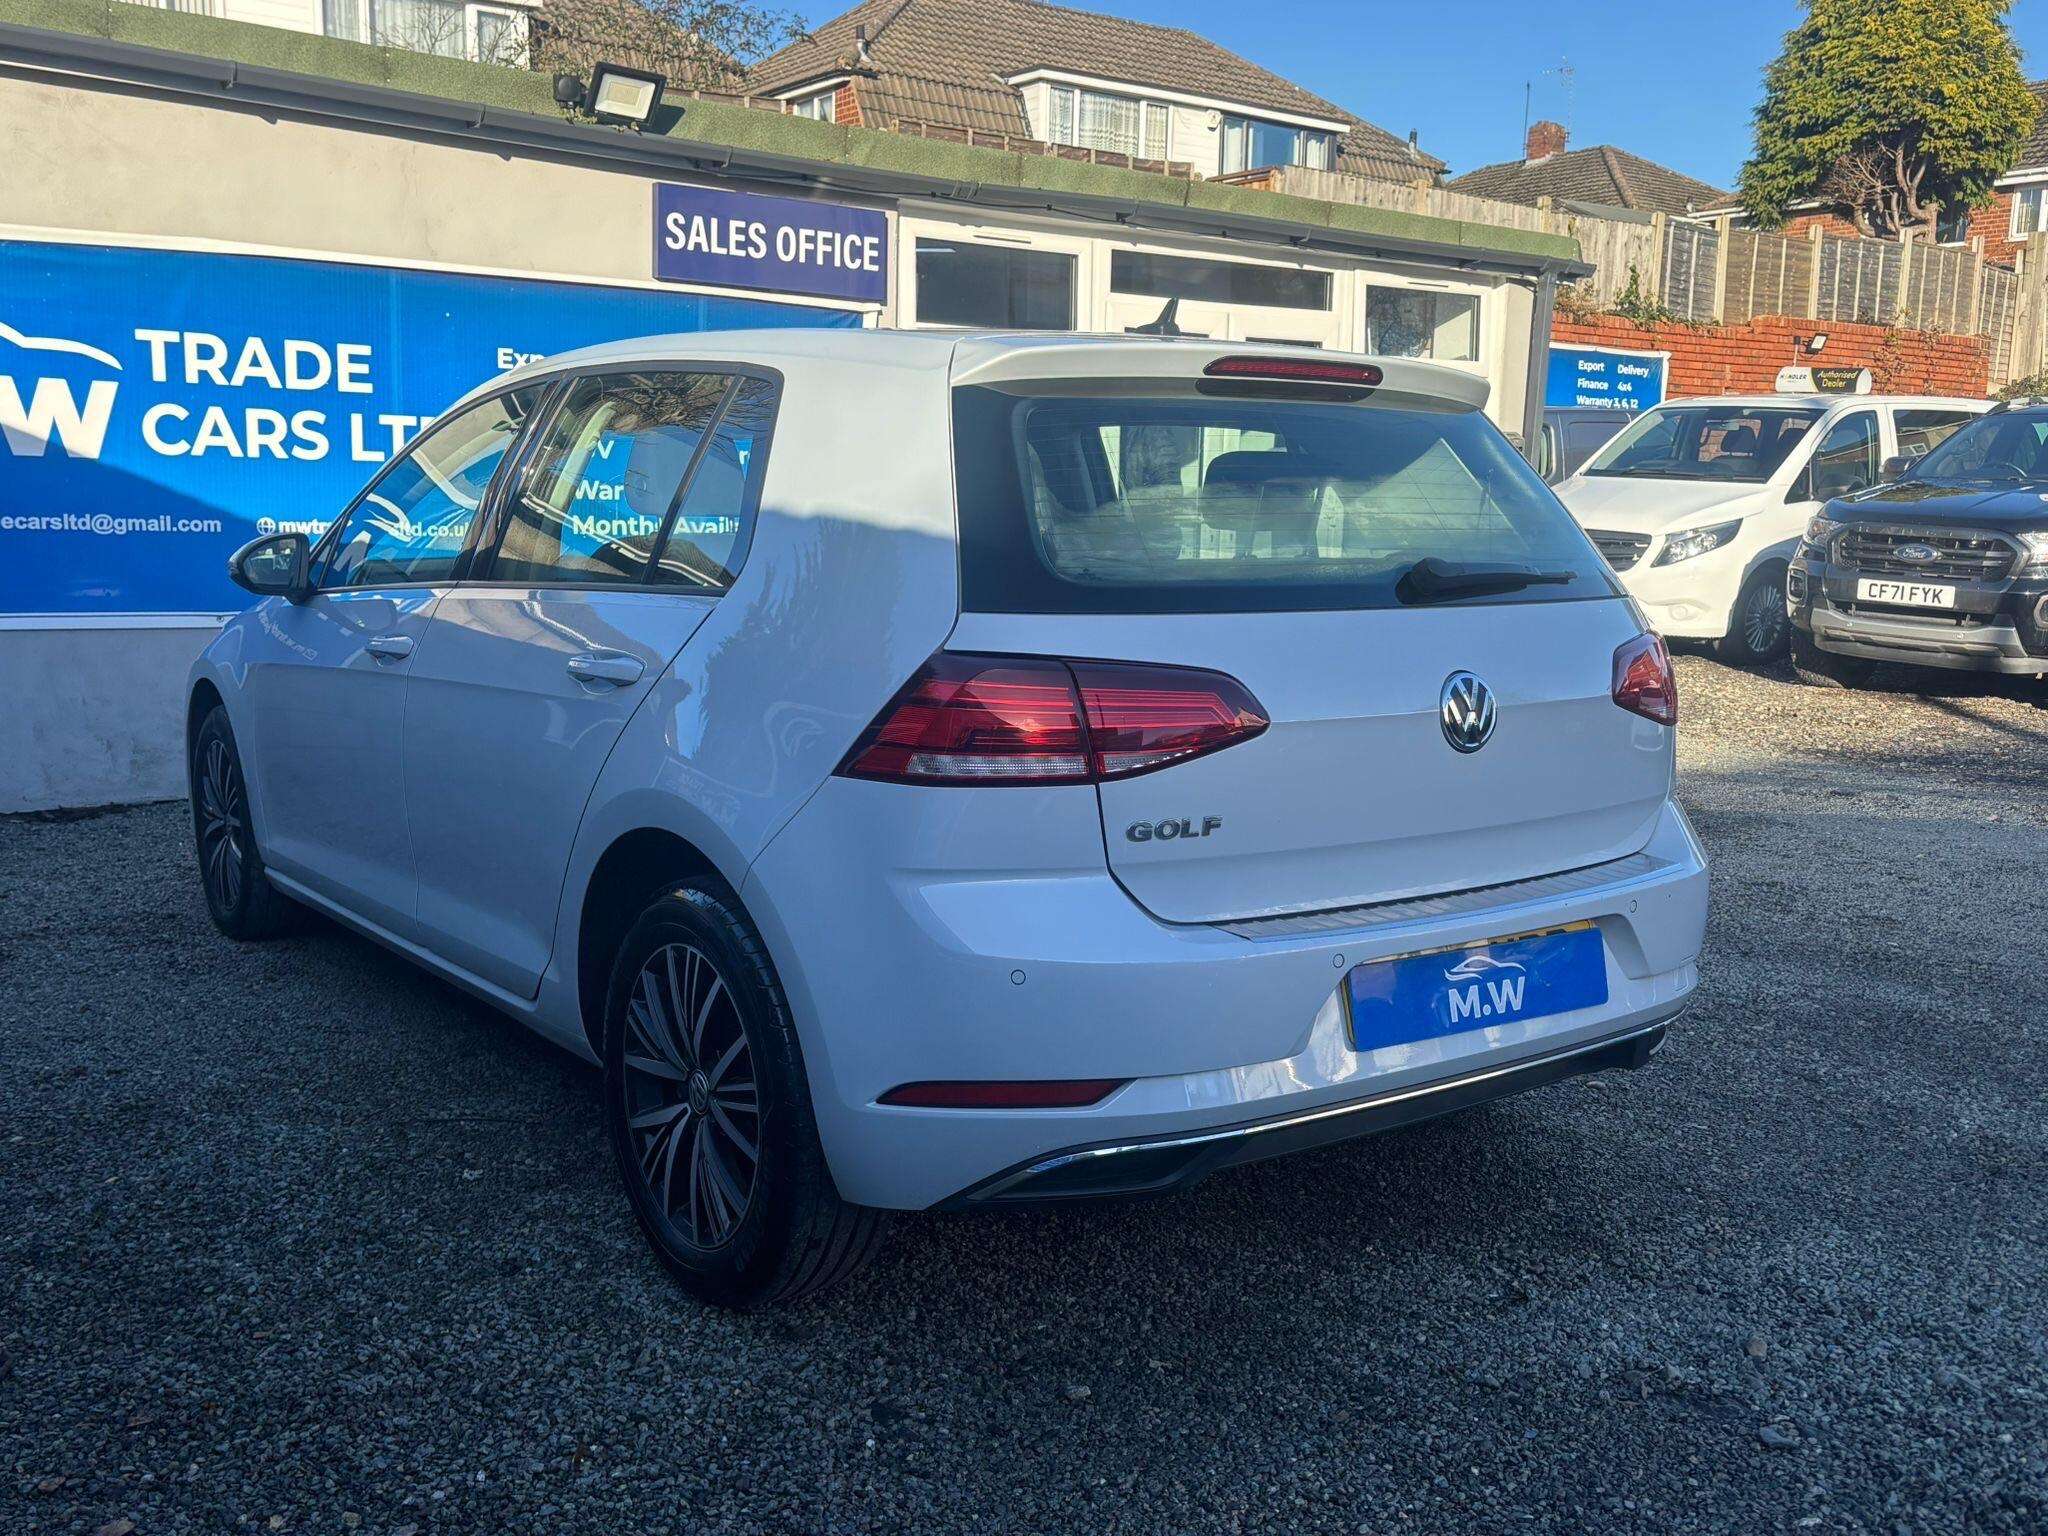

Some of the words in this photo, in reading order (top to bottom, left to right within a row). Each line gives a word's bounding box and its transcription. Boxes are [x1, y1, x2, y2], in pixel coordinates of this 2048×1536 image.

[665, 211, 768, 260] SALES
[775, 225, 880, 273] OFFICE
[134, 328, 374, 394] TRADE
[1578, 360, 1605, 373] Export
[1617, 364, 1650, 378] Delivery
[1817, 365, 1859, 379] Authorised
[1577, 378, 1609, 391] Finance
[1822, 378, 1847, 389] Dealer
[1576, 394, 1614, 409] Warranty
[141, 402, 330, 461] CARS
[350, 412, 437, 462] LT
[0, 512, 222, 535] ecarsltd@gmail.com
[1902, 547, 1927, 560] Ford
[1868, 582, 1905, 601] CF71
[1908, 586, 1943, 605] FYK
[1125, 815, 1224, 843] GOLF
[1447, 976, 1526, 1024] M.W
